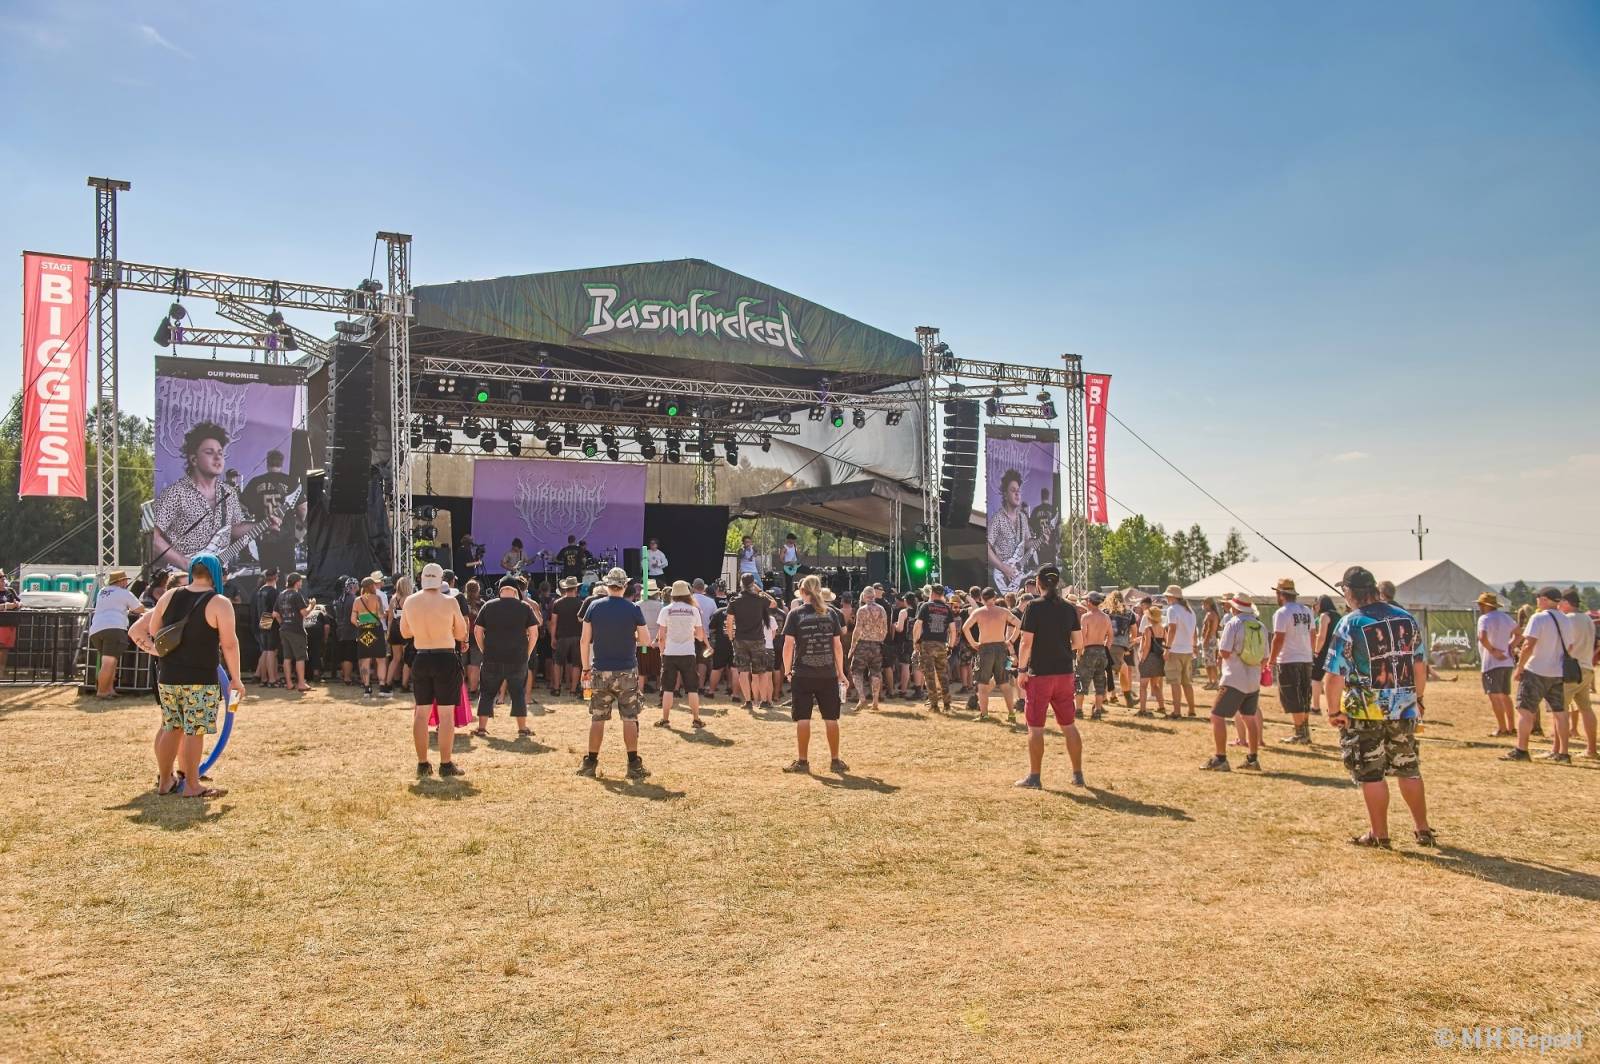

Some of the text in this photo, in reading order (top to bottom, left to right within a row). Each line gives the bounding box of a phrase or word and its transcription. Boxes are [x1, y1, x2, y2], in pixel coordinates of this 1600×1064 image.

[41, 261, 73, 272] STAGE
[225, 371, 260, 380] PROMISE
[36, 273, 73, 495] BIGGEST
